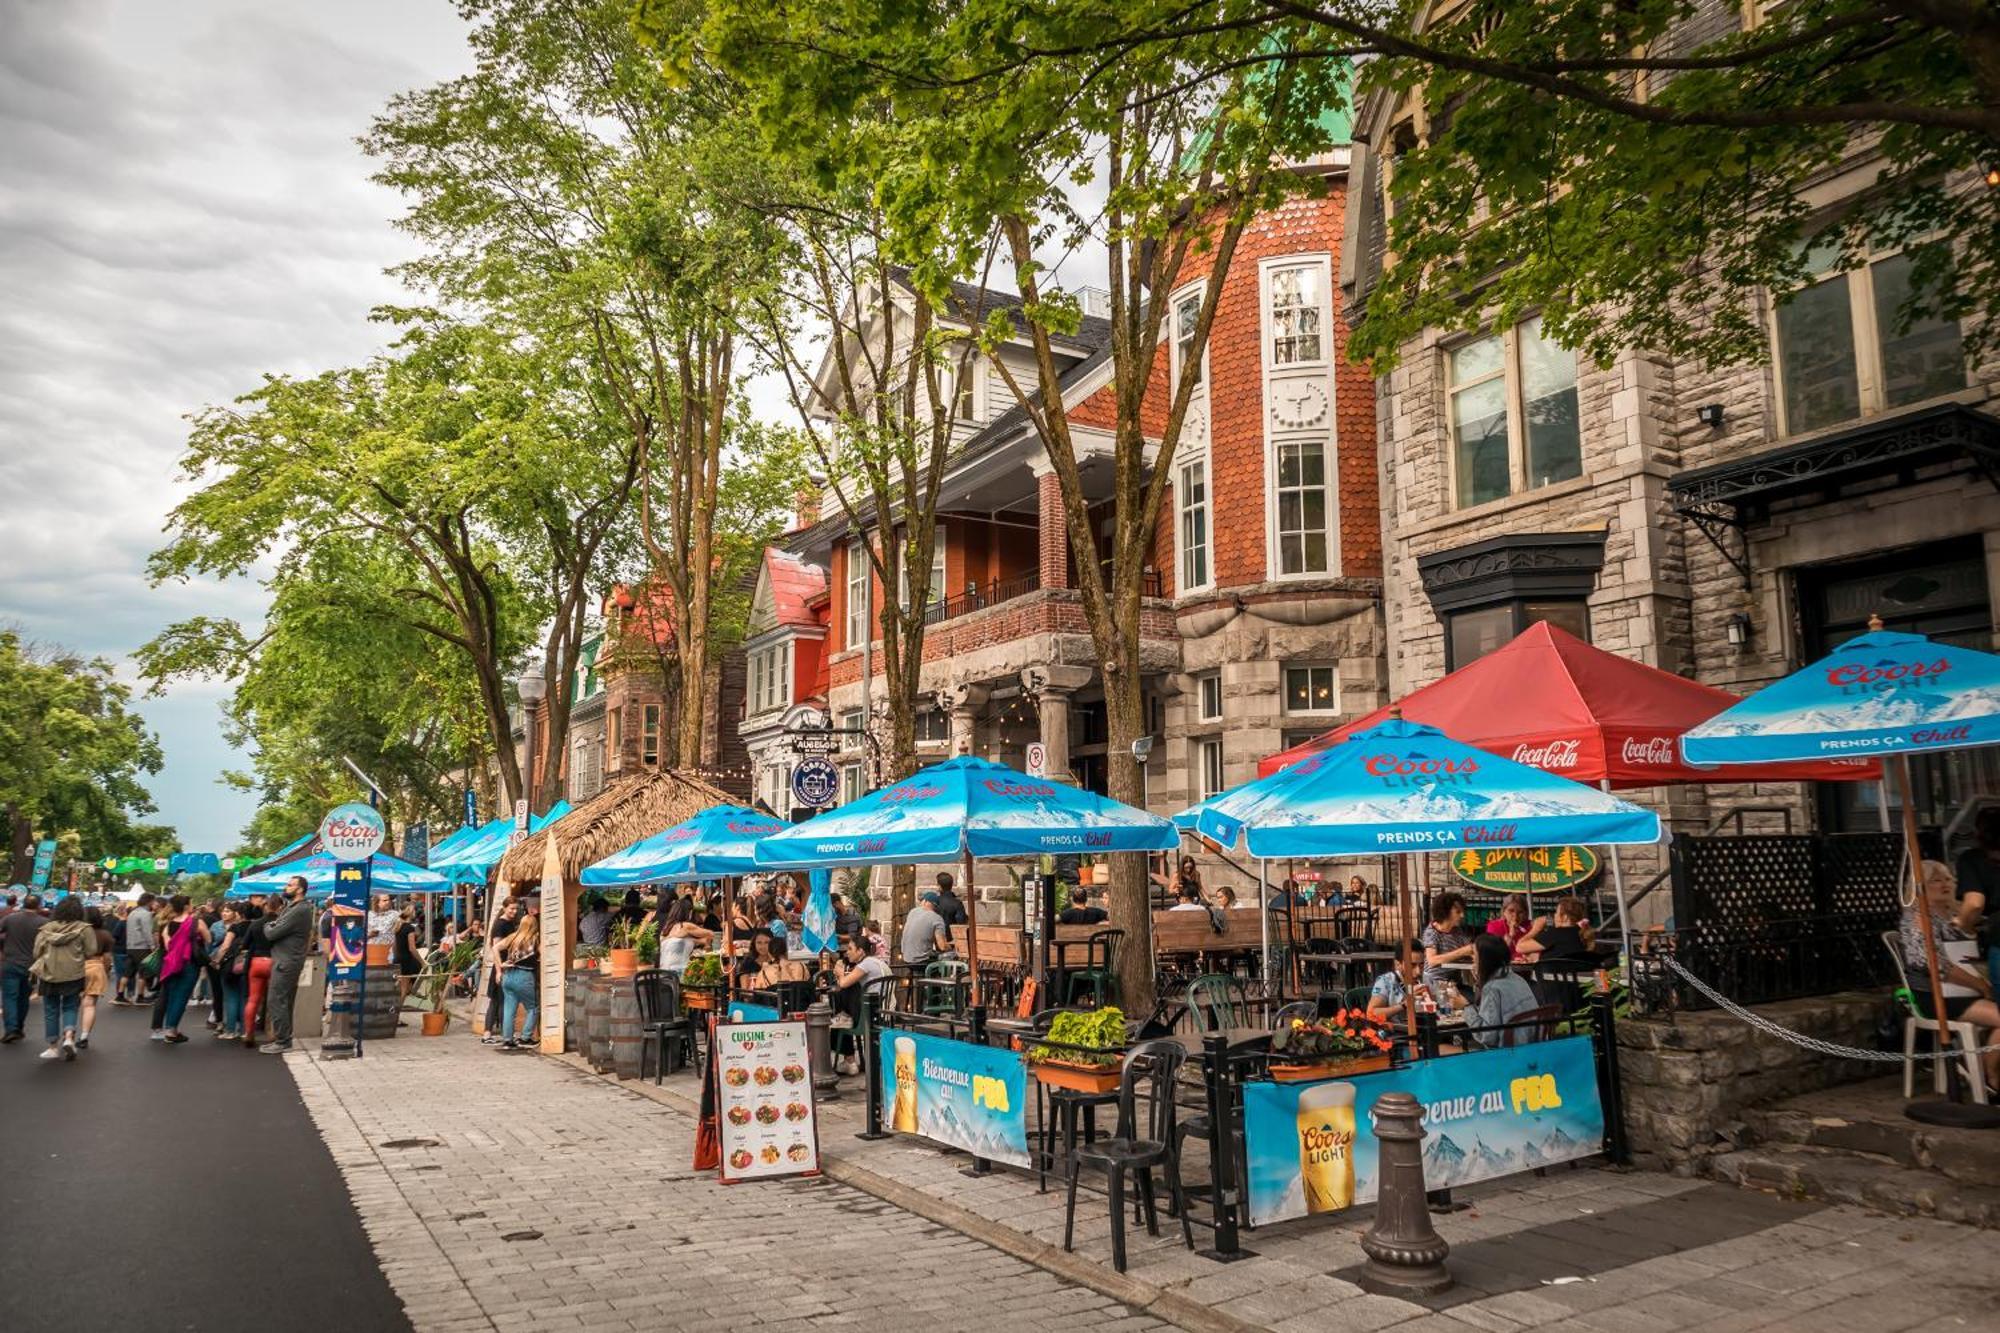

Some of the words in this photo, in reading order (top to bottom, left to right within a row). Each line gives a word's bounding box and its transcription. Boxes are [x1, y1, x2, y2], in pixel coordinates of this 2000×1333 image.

[1825, 657, 1952, 686] Coors
[1842, 674, 1941, 695] LIGHT
[1820, 738, 1879, 750] PRENDS
[1883, 736, 1904, 747] ÇA
[1910, 724, 1973, 744] Chill
[1360, 752, 1481, 777] Coors
[1383, 772, 1473, 788] LIGHT
[328, 820, 379, 838] Coors
[1377, 831, 1434, 844] PRENDS
[1436, 830, 1457, 845] ÇA
[1461, 823, 1518, 843] Chill
[333, 839, 374, 848] LIGHT
[1040, 835, 1070, 847] PRENDS
[1485, 871, 1525, 882] RESTAURANT
[1530, 872, 1558, 883] IBANAIS
[731, 1031, 765, 1043] CUISINE
[922, 1057, 969, 1088] Bienvenue
[940, 1083, 953, 1099] au
[1479, 1090, 1505, 1115] au
[1301, 1126, 1353, 1152] Coors
[1309, 1147, 1345, 1165] LIGHT
